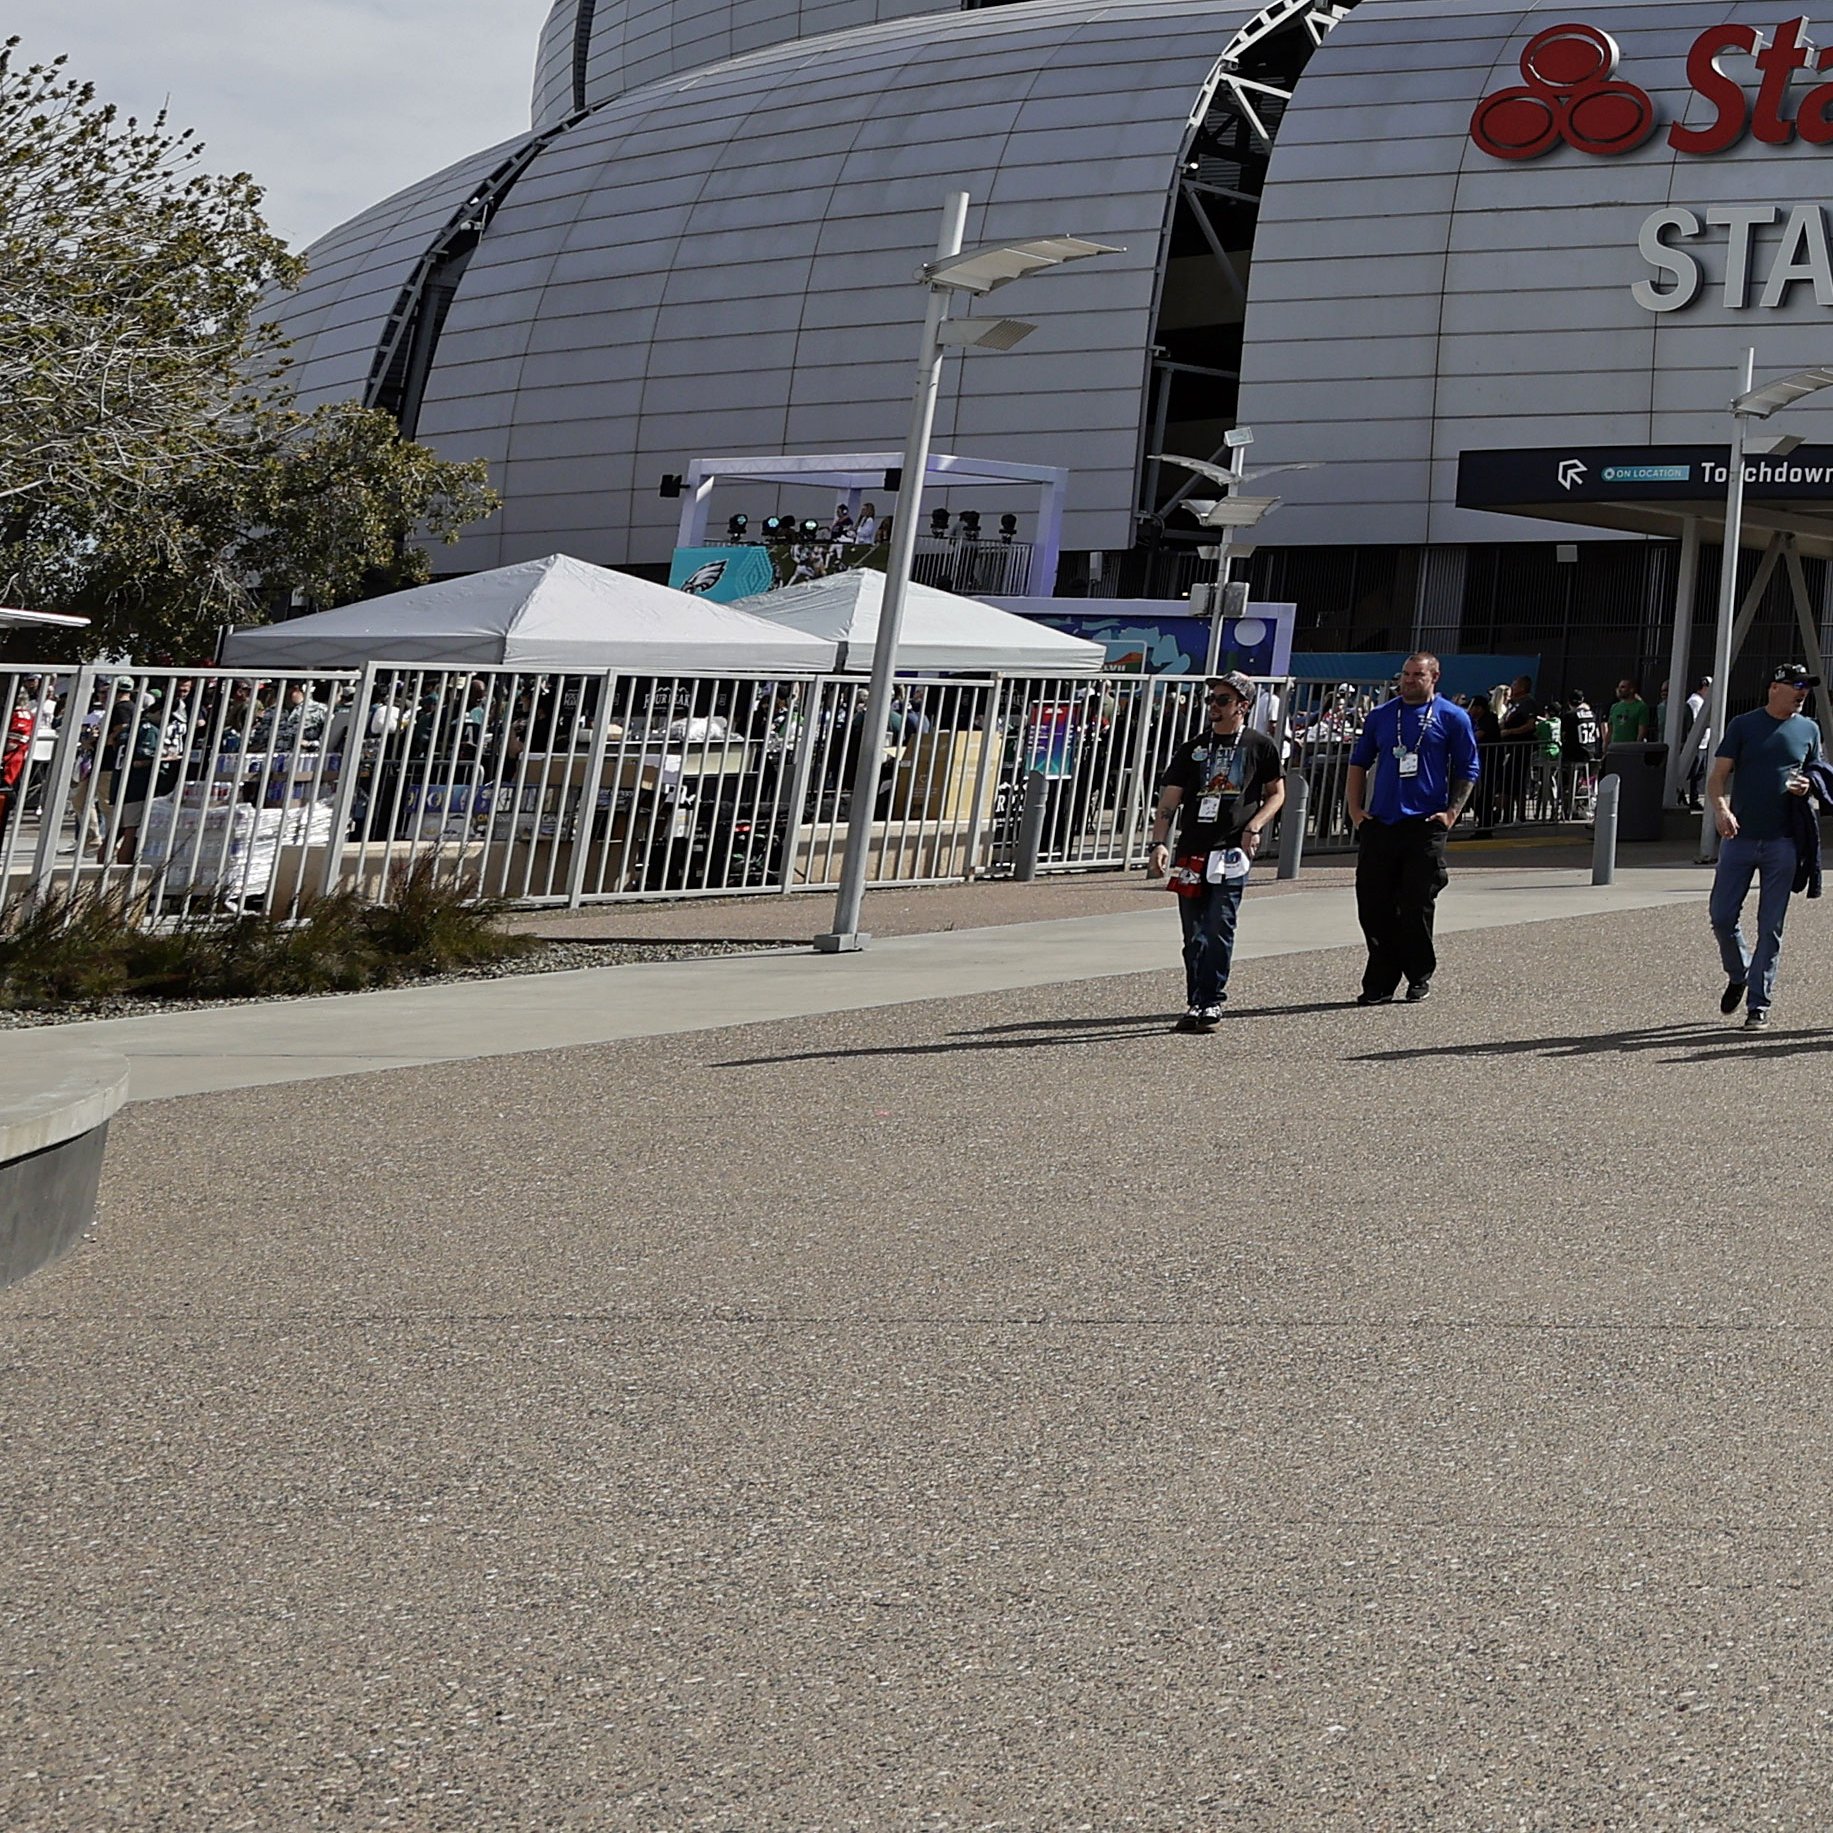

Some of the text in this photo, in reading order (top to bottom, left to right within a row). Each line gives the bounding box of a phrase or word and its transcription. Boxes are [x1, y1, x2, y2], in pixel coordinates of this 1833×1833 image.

[1617, 468, 1682, 478] ON LOCATION
[1577, 722, 1596, 744] 62
